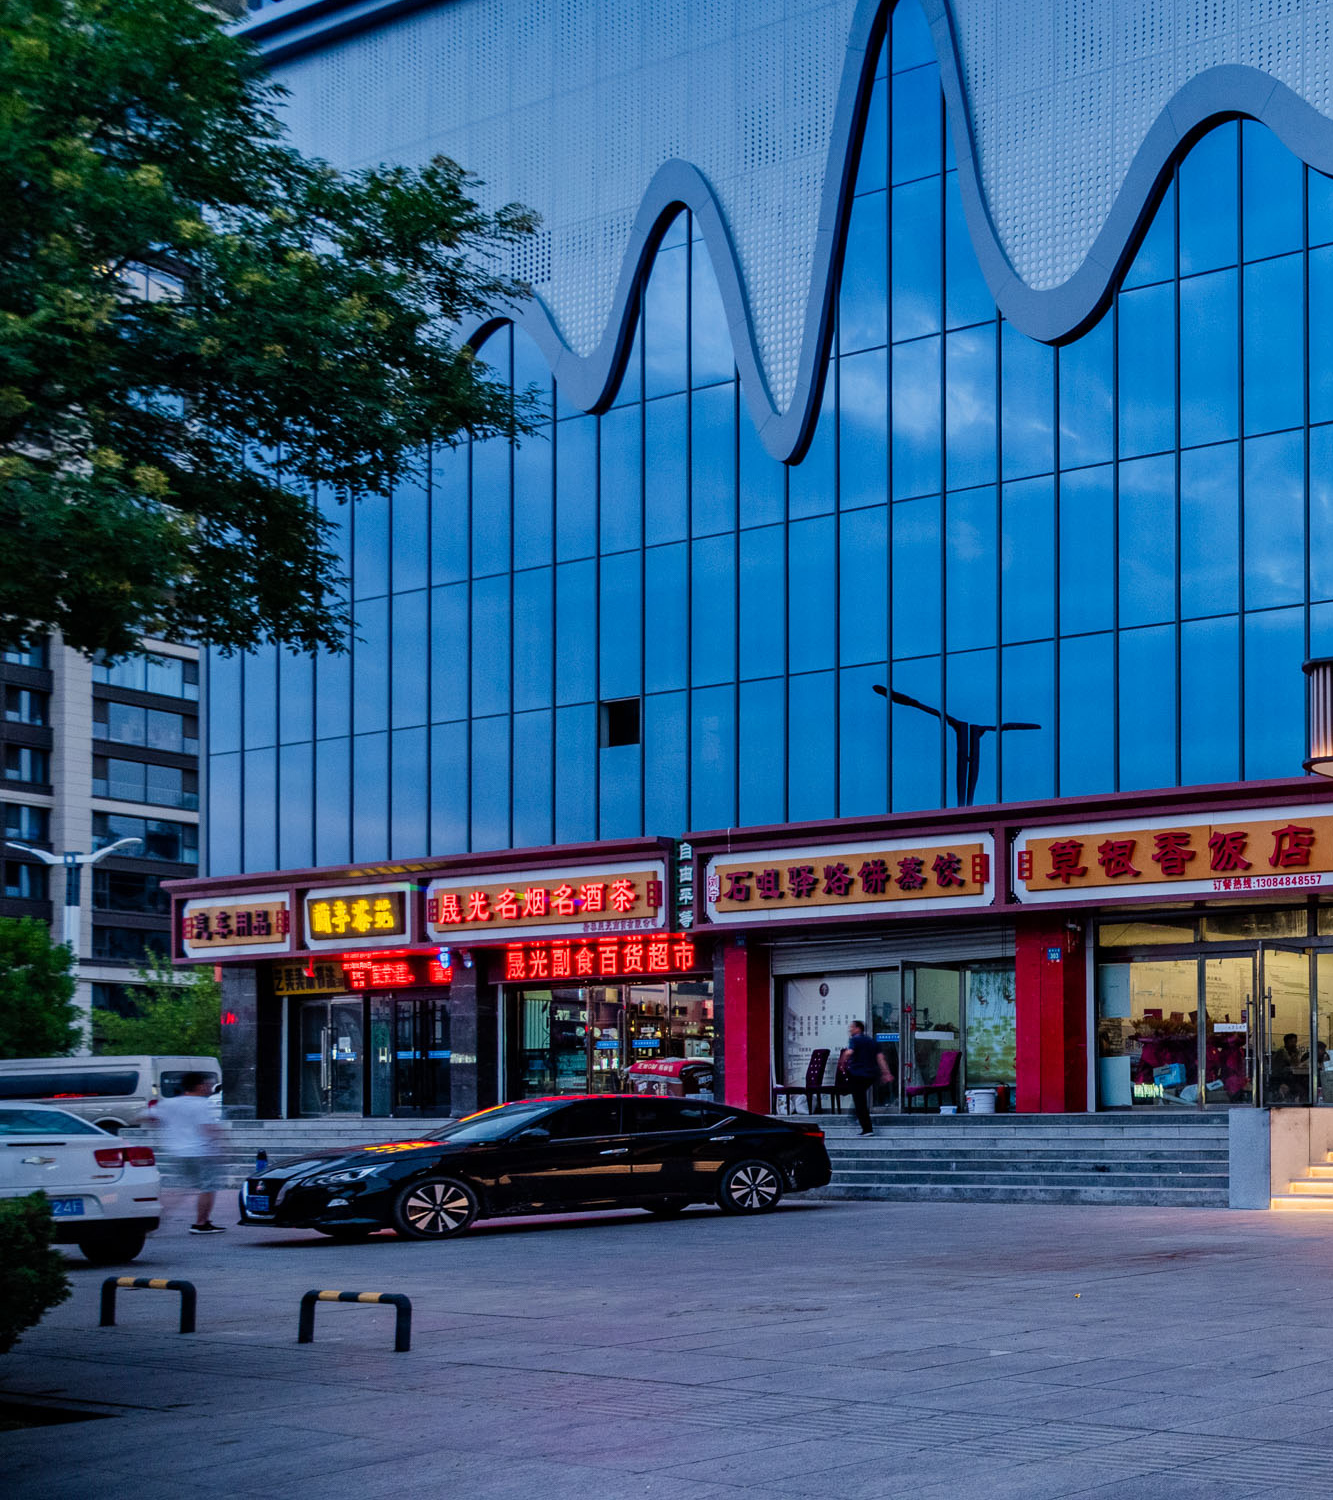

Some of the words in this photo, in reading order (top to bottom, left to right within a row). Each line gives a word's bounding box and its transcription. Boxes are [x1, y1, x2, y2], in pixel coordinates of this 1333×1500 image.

[1046, 824, 1315, 884] 草根香饭店
[439, 878, 636, 925] 晟光名烟名酒茶
[679, 842, 693, 928] 自由平等
[506, 940, 696, 980] 晟光副食百货超市
